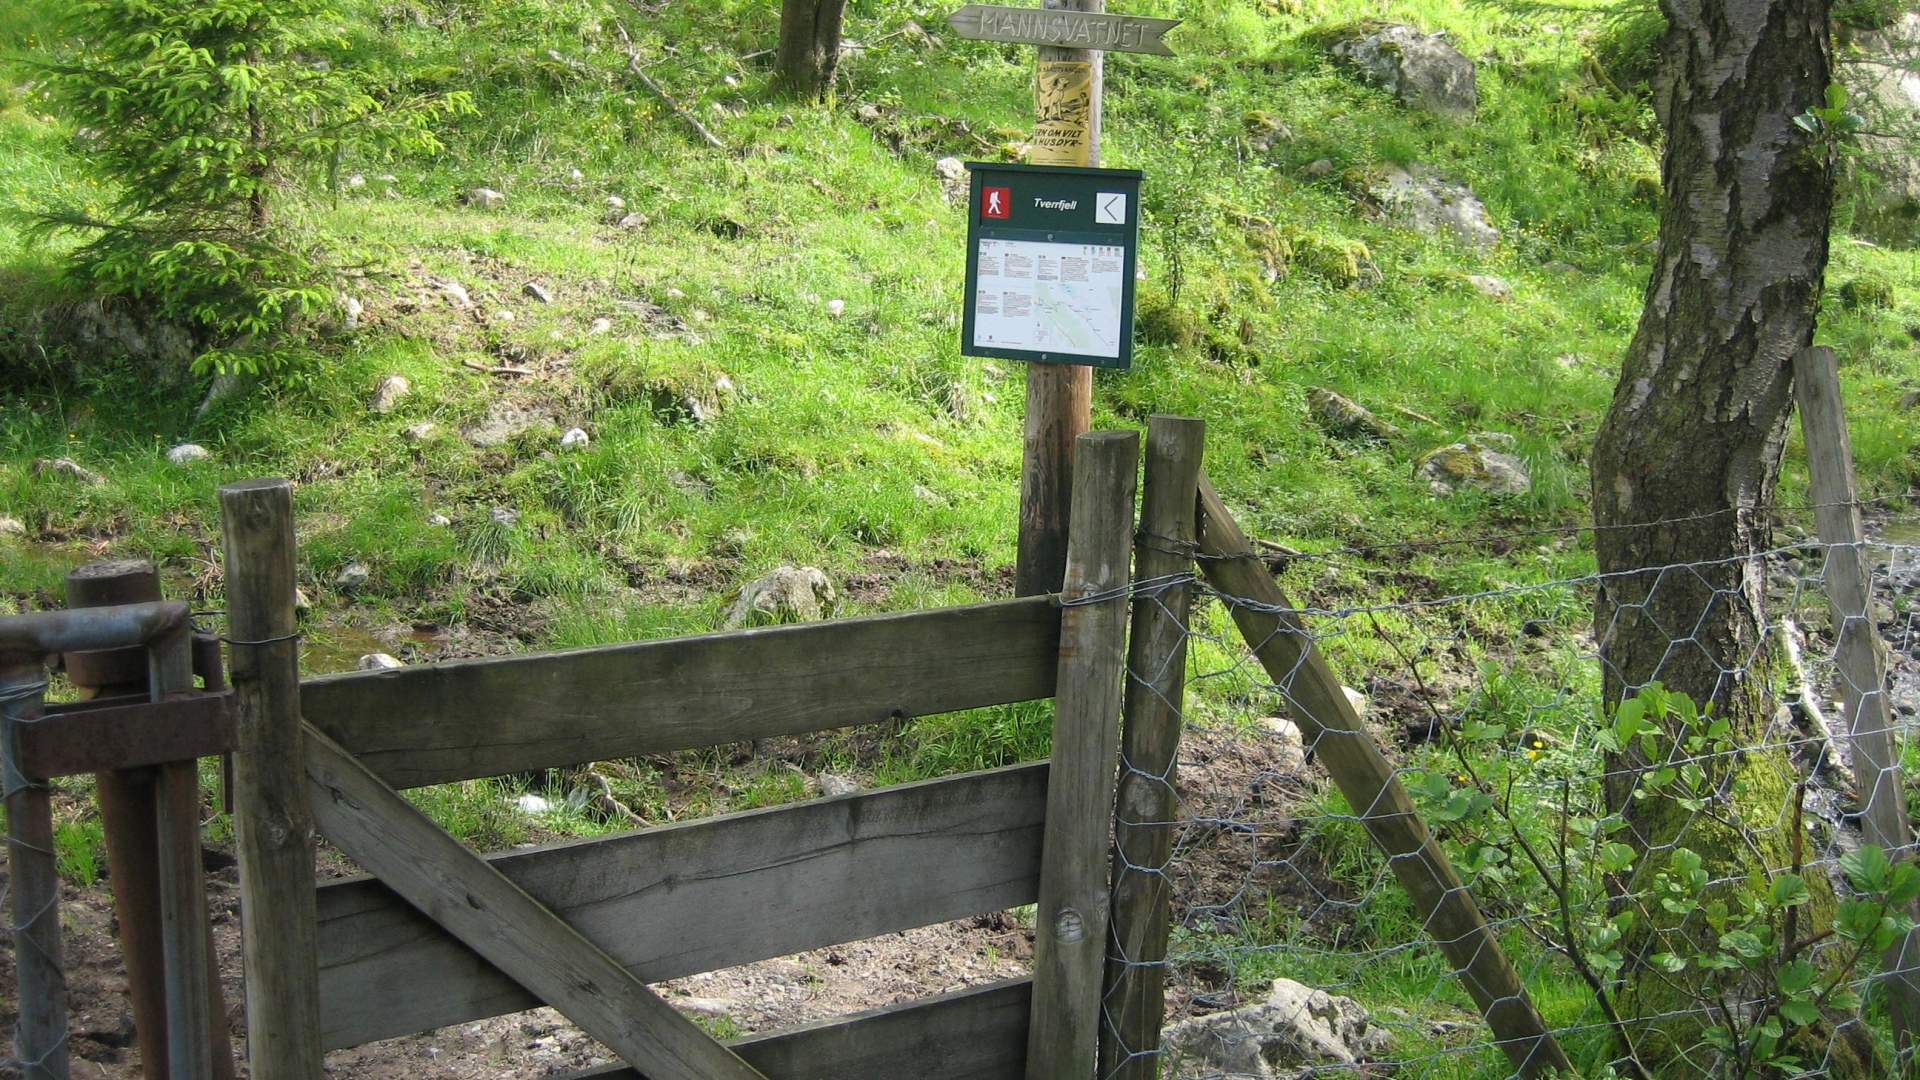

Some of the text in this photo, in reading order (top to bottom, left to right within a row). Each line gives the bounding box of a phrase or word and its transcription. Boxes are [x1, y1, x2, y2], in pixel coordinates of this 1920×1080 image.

[979, 9, 1149, 48] MANNSVATNET
[1048, 129, 1062, 137] OM
[1062, 129, 1084, 138] VILT
[1034, 197, 1078, 211] Tverrfjell
